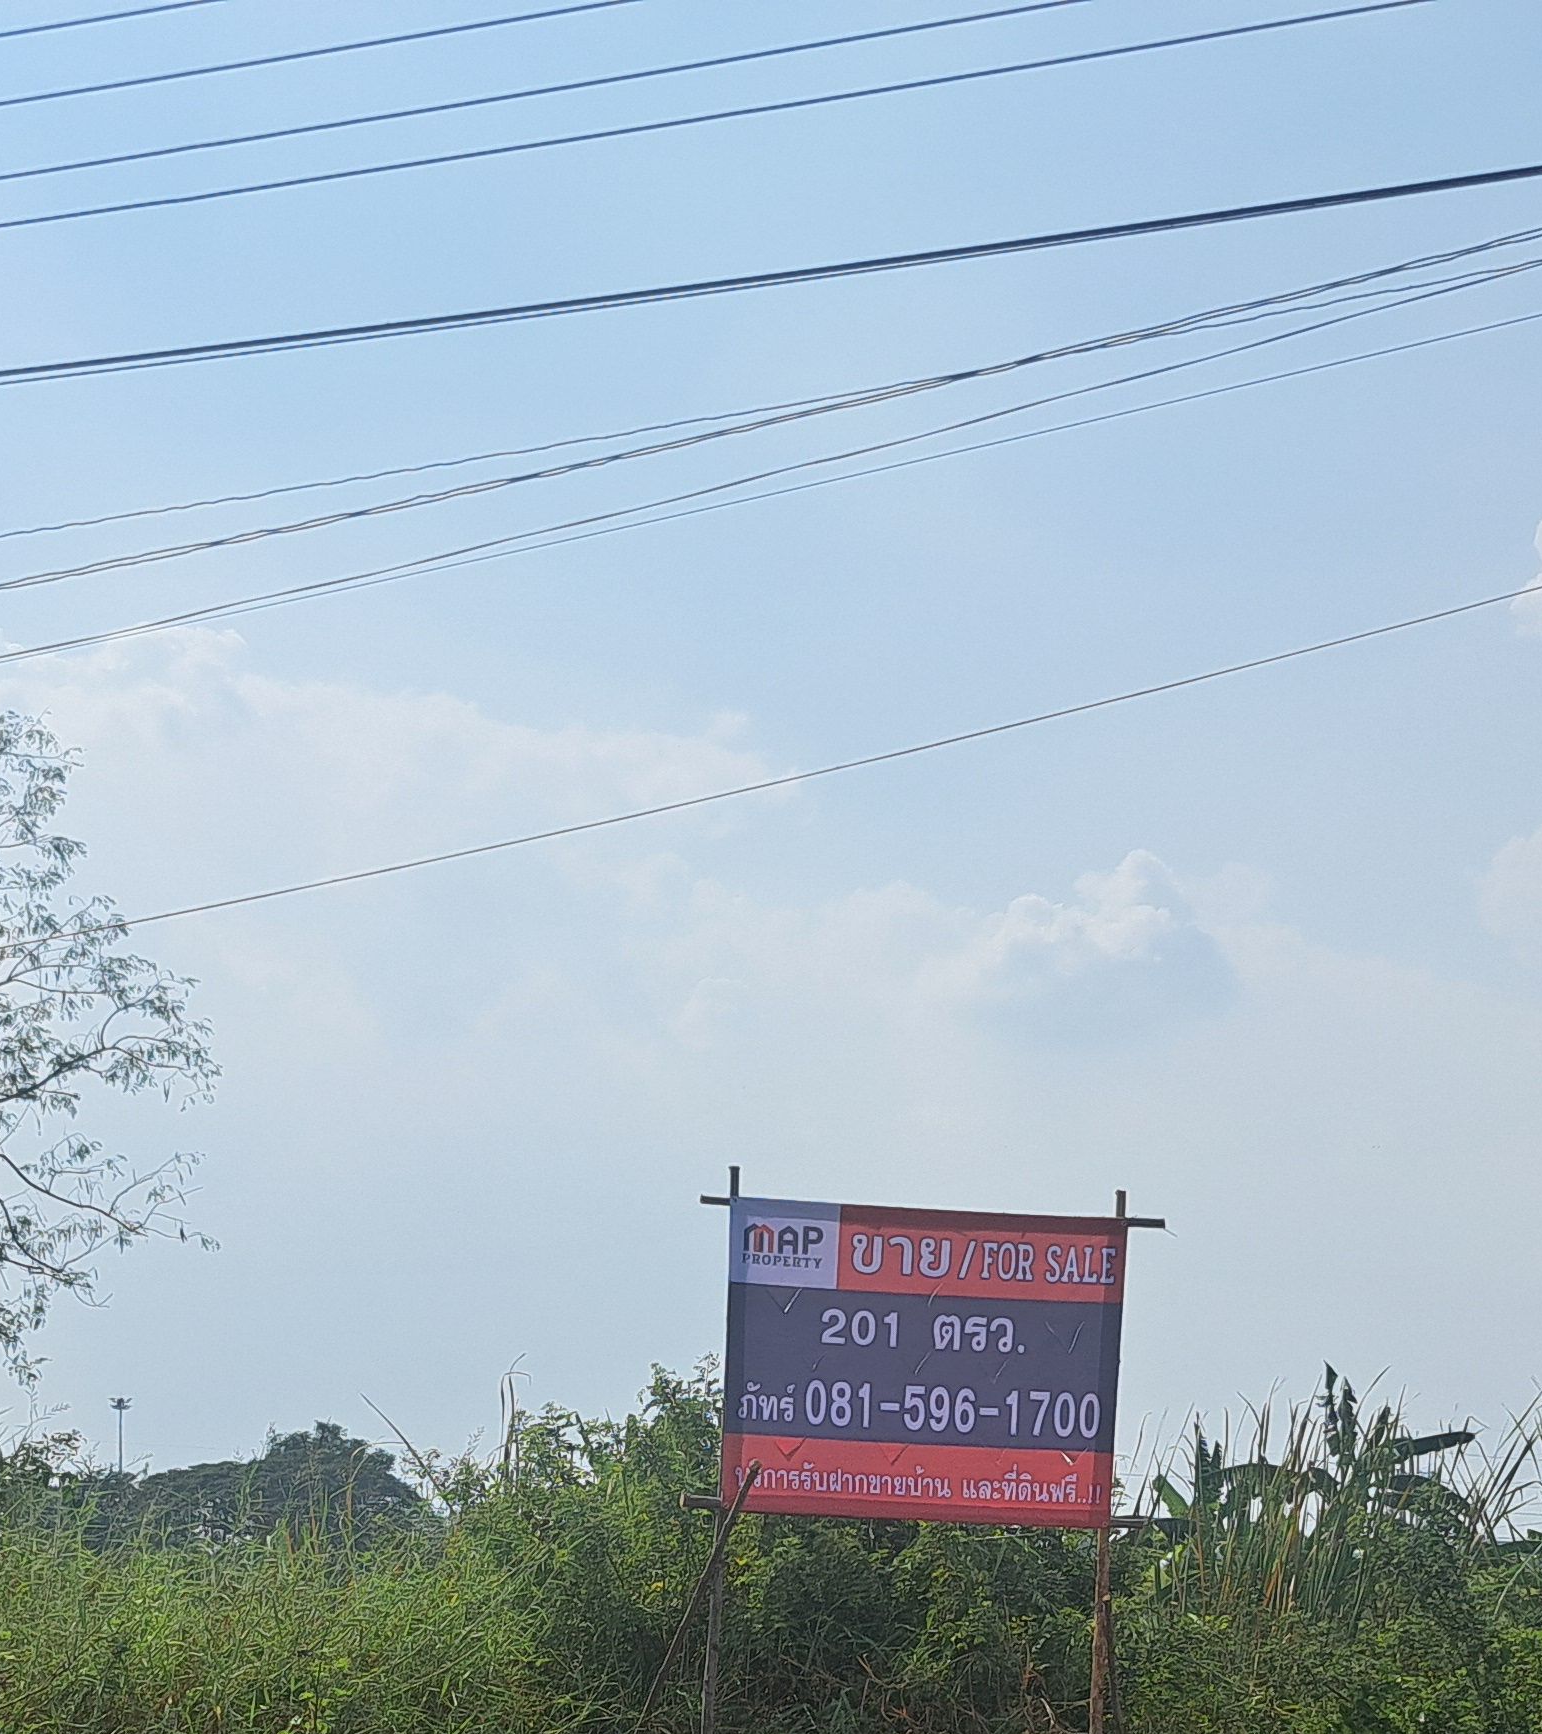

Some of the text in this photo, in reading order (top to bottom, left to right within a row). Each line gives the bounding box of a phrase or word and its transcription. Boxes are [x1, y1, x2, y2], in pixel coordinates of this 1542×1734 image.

[743, 1222, 825, 1256] MAP
[741, 1251, 824, 1270] PROPERTY
[1045, 1244, 1117, 1285] SALE
[820, 1307, 1026, 1354] 201 ตรว.
[736, 1378, 1102, 1440] ภัทร์ 081-596-1700
[734, 1459, 952, 1499] บรการรับฝากขายบ้าน
